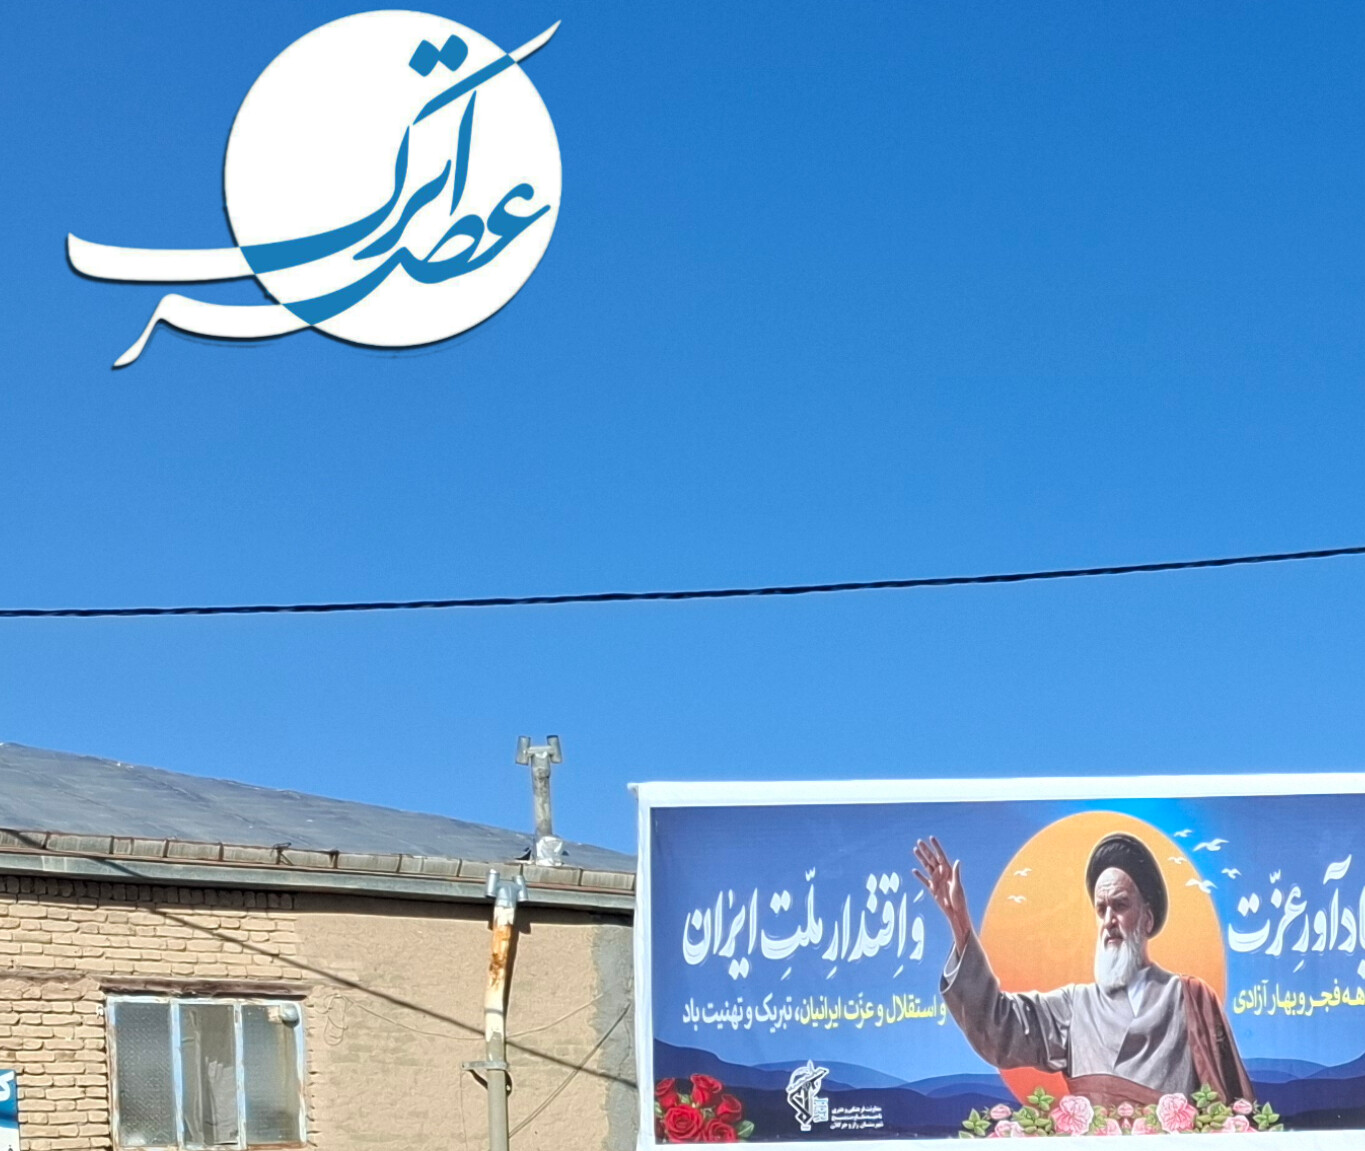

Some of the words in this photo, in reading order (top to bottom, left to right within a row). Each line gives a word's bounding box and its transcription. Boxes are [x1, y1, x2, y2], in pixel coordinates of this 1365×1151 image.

[701, 995, 744, 1031] تهنیت
[755, 992, 793, 1033] تبریک
[886, 993, 937, 1025] استقلال
[937, 1000, 947, 1027] و
[1233, 979, 1268, 1015] آزادی
[1267, 982, 1298, 1016] بهار
[1305, 978, 1342, 1017] فجر
[682, 997, 700, 1032] باد
[744, 1005, 753, 1029] و
[875, 1001, 885, 1028] و
